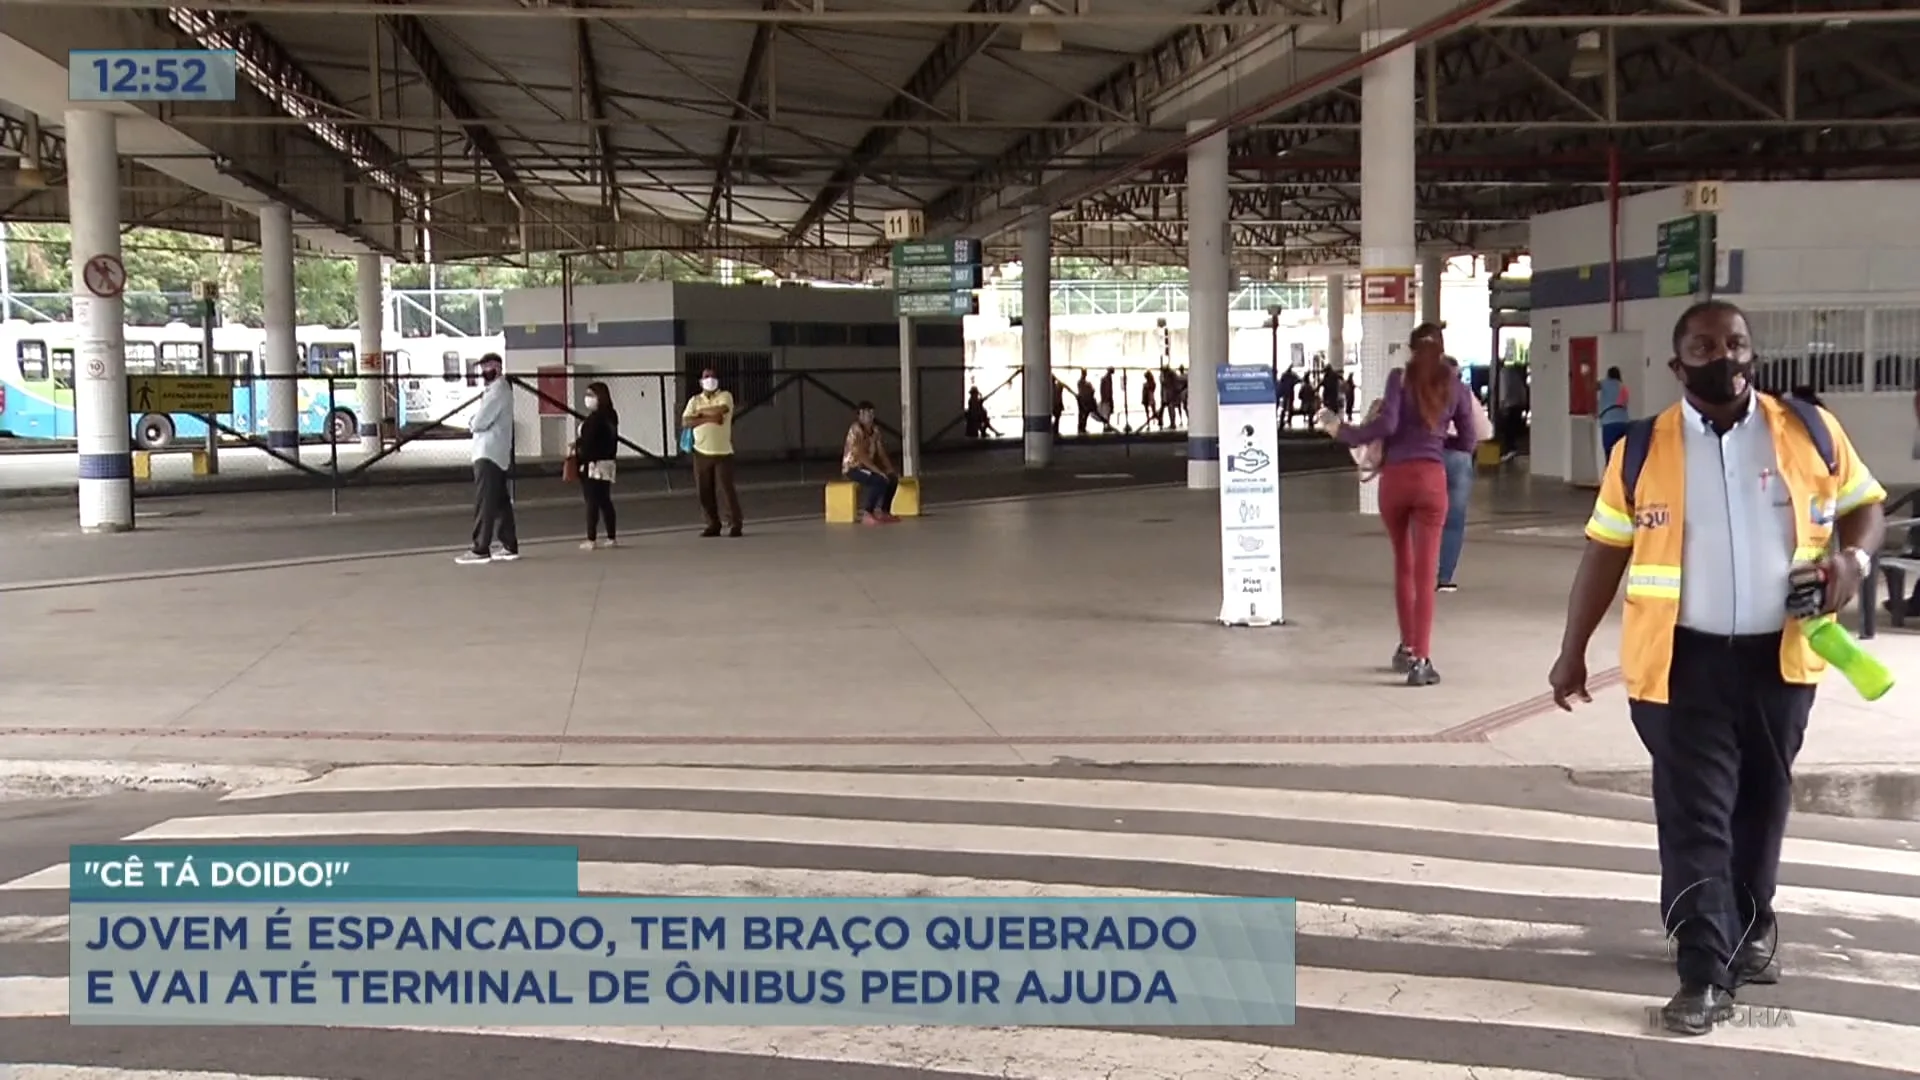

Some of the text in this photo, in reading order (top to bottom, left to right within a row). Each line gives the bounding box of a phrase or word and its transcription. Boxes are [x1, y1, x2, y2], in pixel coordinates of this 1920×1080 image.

[1701, 185, 1718, 205] 01
[890, 215, 903, 233] 11
[911, 215, 921, 233] 11
[1365, 276, 1396, 304] E
